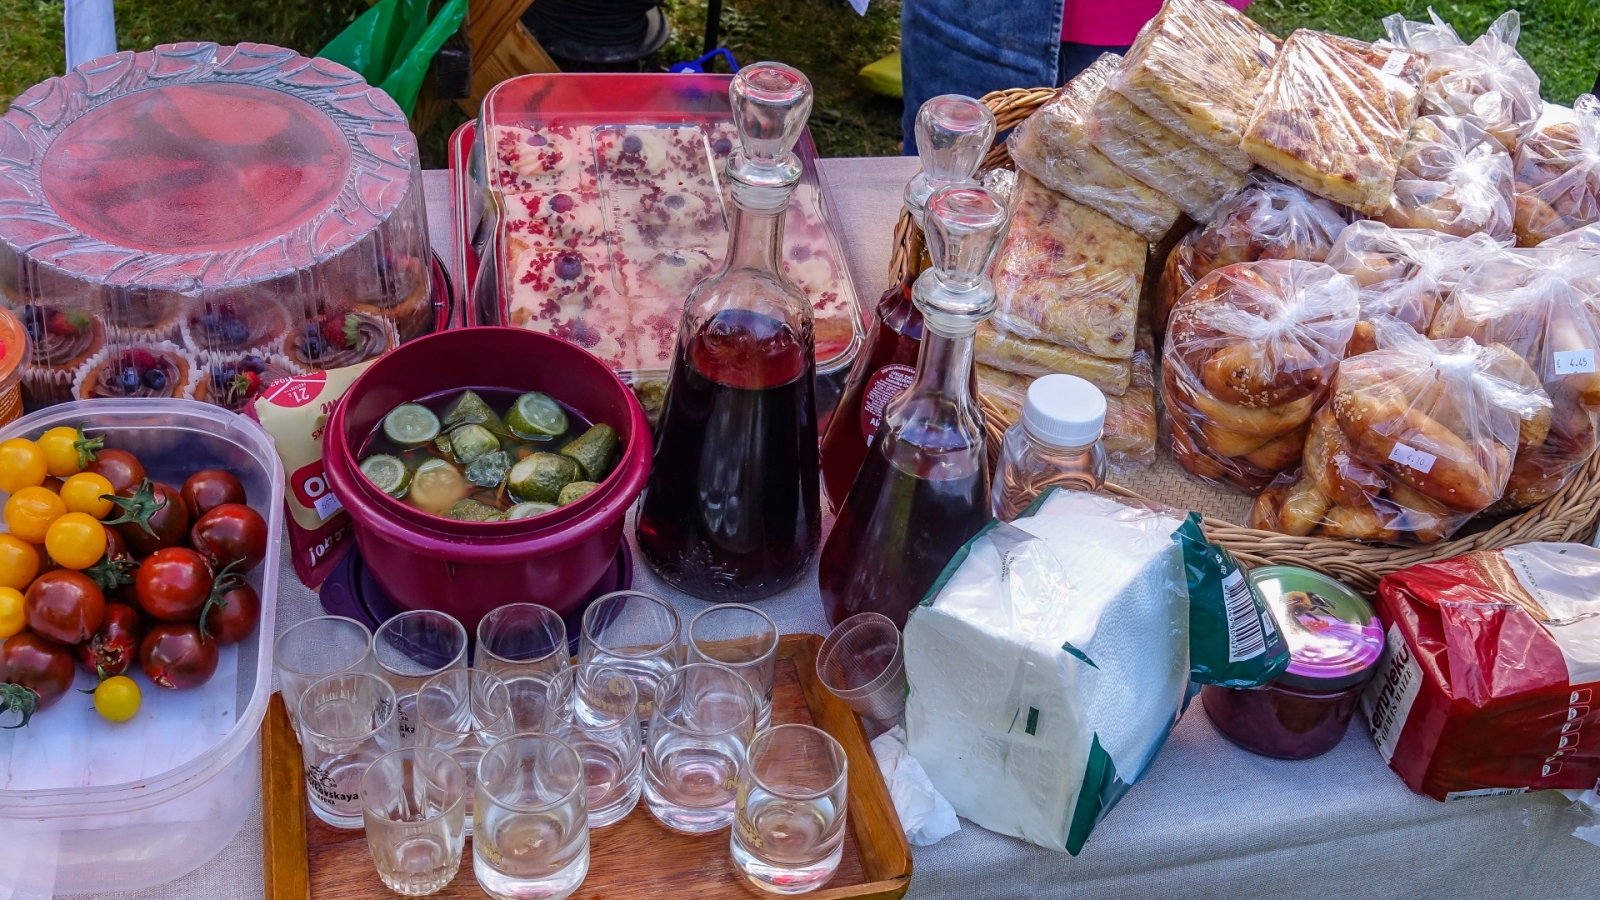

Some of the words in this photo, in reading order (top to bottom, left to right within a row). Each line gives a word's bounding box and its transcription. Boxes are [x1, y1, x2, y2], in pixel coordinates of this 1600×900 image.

[1569, 357, 1588, 367] 4.45
[292, 387, 310, 403] 21
[1406, 454, 1425, 466] 4.10
[1394, 667, 1413, 704] MAIZE
